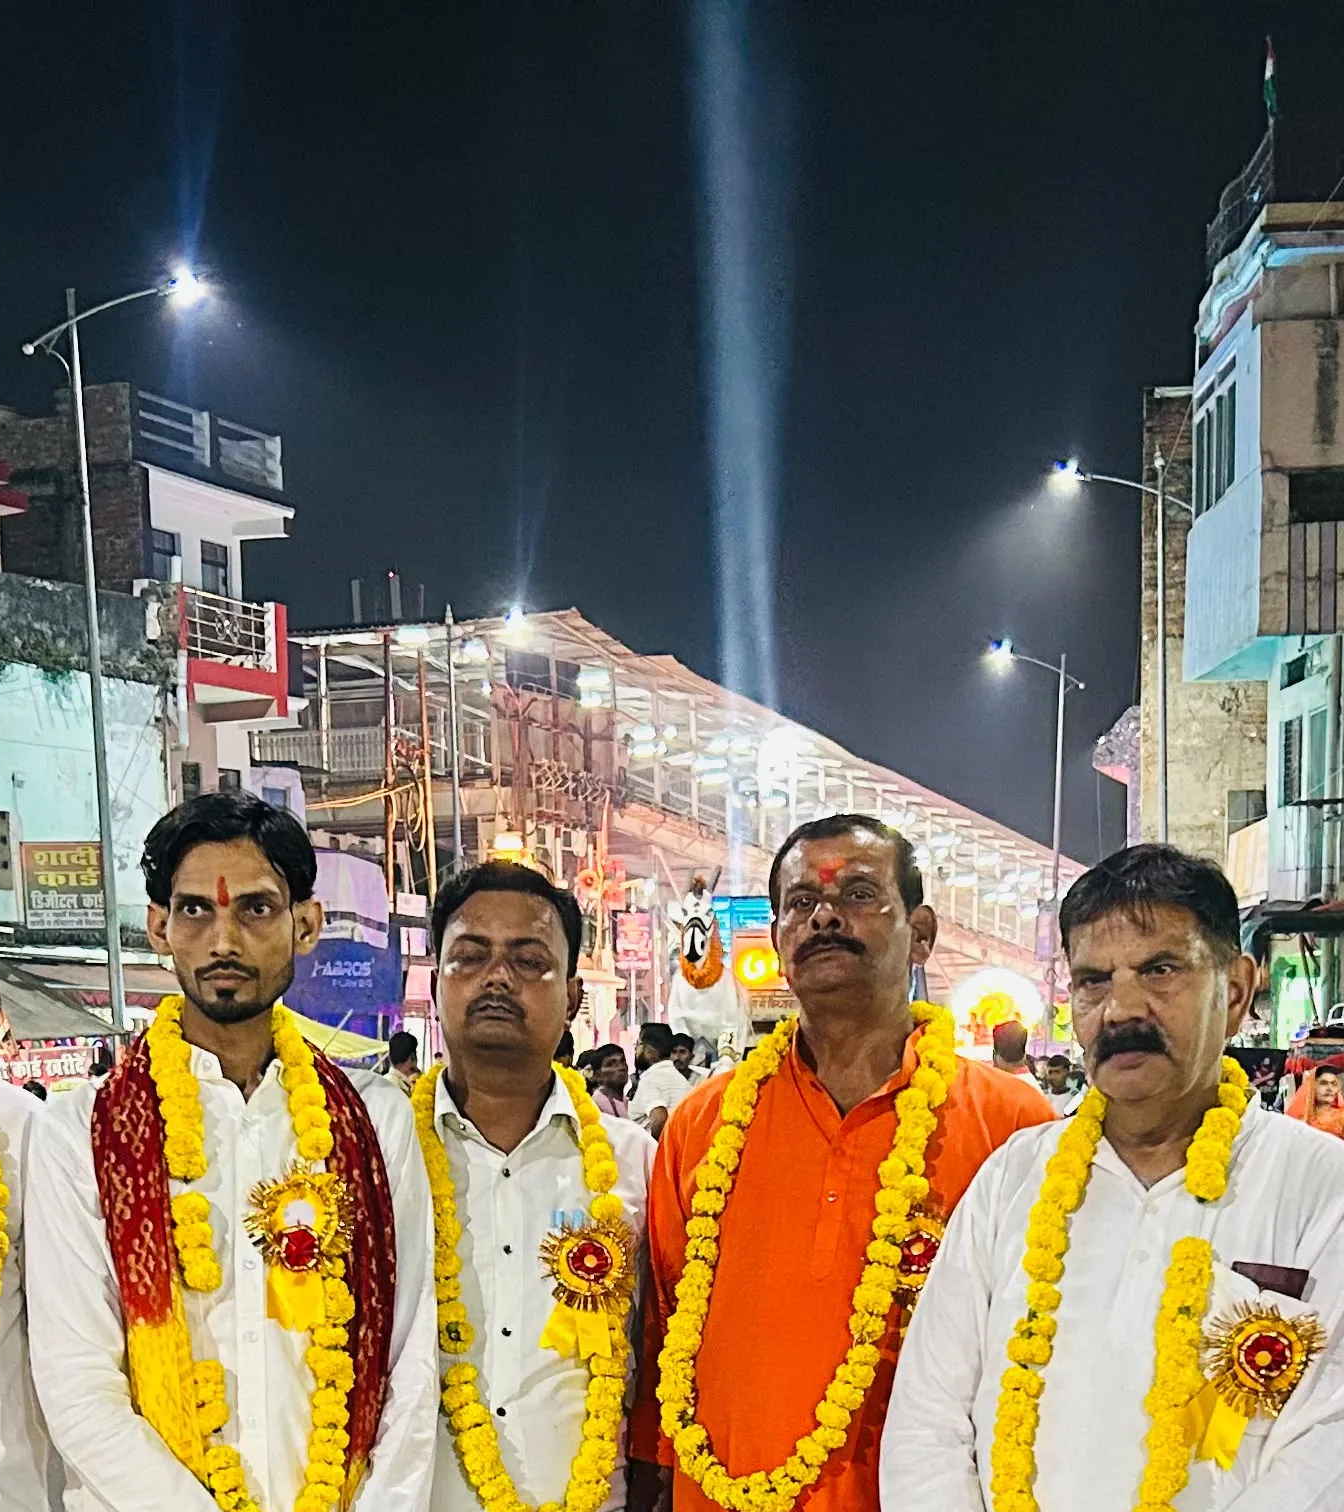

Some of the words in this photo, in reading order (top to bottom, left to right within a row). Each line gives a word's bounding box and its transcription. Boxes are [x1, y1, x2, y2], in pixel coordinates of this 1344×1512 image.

[33, 846, 100, 866] शादी
[34, 866, 100, 888] कार्ड
[30, 890, 78, 909] डिजीटल
[10, 1055, 43, 1079] कार्ड
[43, 1051, 88, 1077] खरीदें
